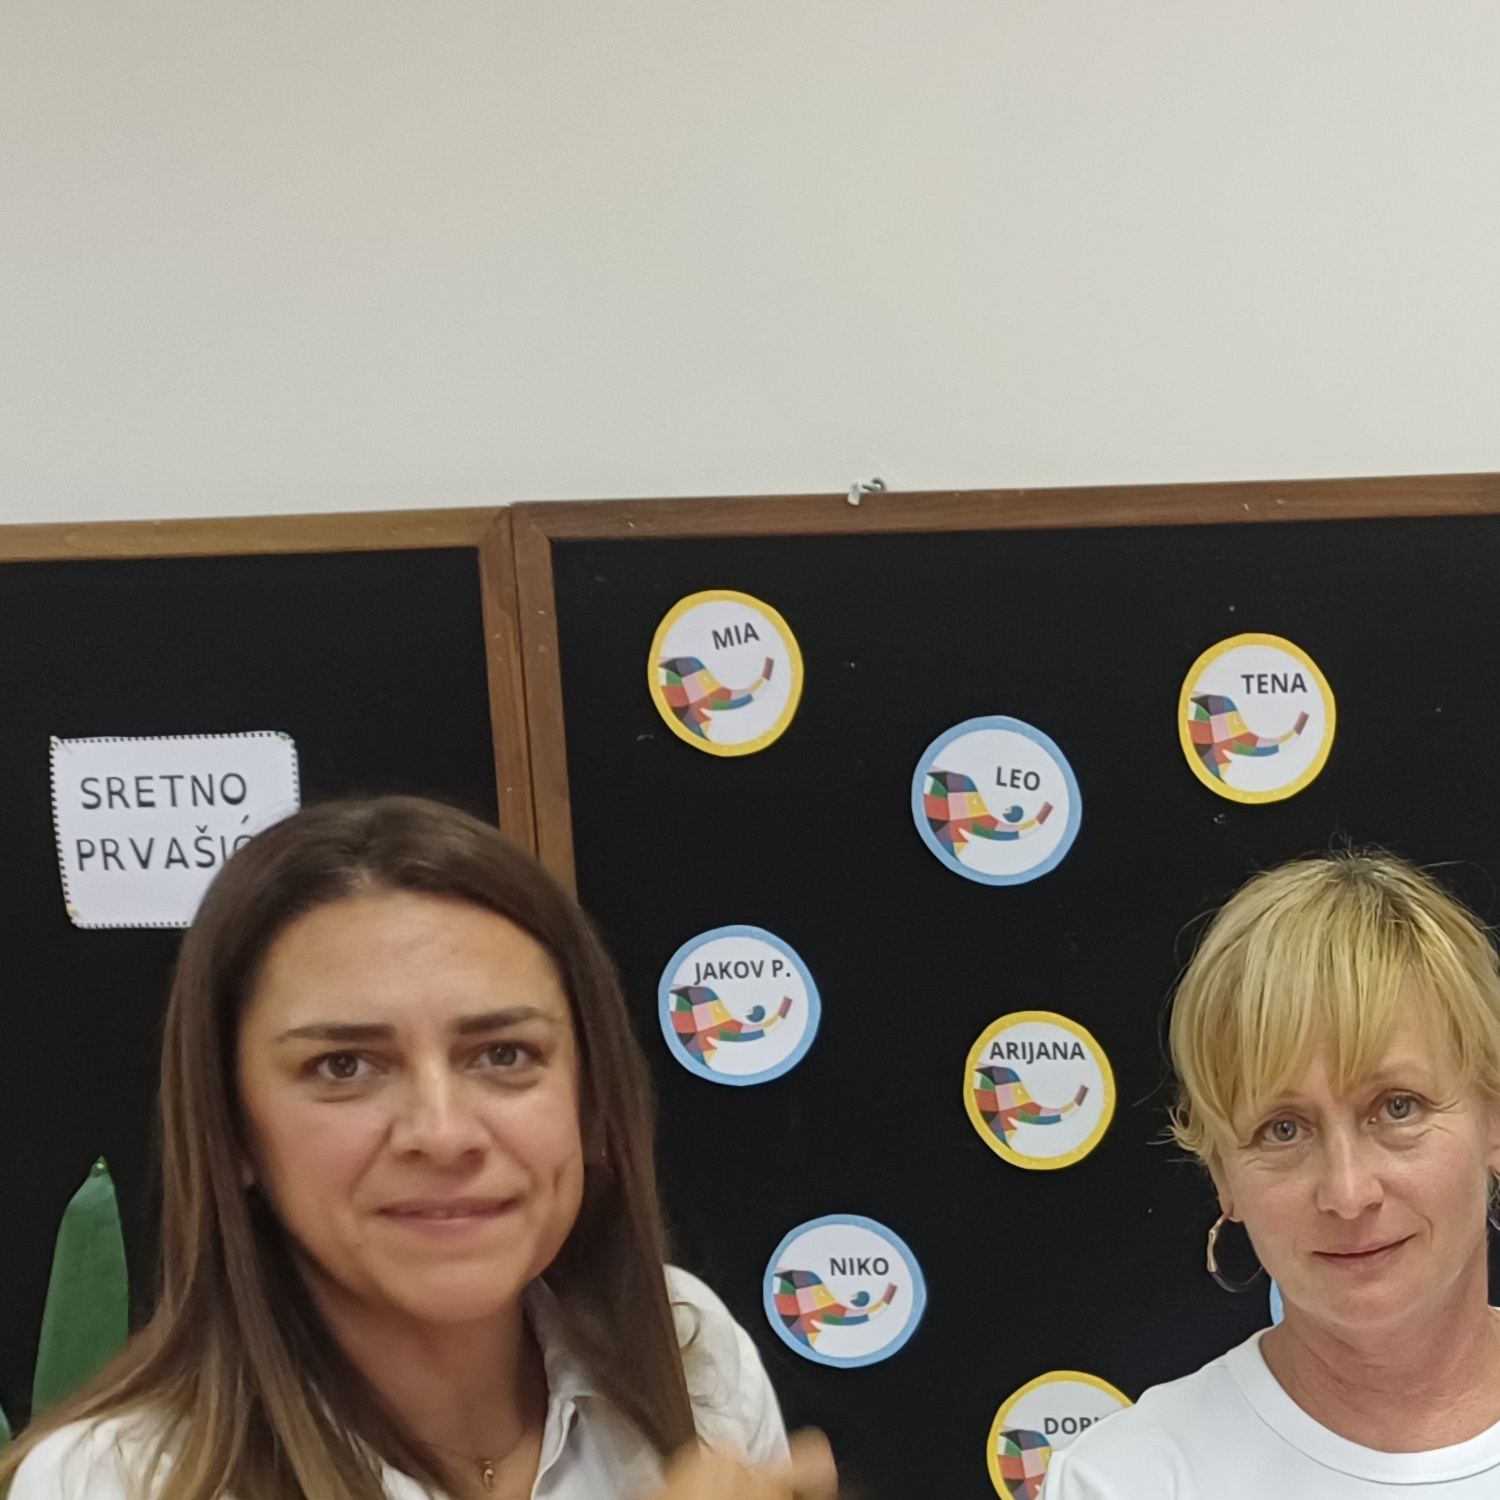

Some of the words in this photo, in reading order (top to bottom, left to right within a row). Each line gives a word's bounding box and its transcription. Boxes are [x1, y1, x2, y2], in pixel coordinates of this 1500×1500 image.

[711, 622, 760, 651] MIA
[1240, 672, 1308, 695] TENA
[80, 772, 247, 810] SRETNO
[995, 766, 1041, 792] LEO
[693, 959, 765, 986] JAKOV
[771, 959, 791, 978] P.
[988, 1041, 1086, 1066] ARIJANA
[829, 1257, 890, 1277] NIKO
